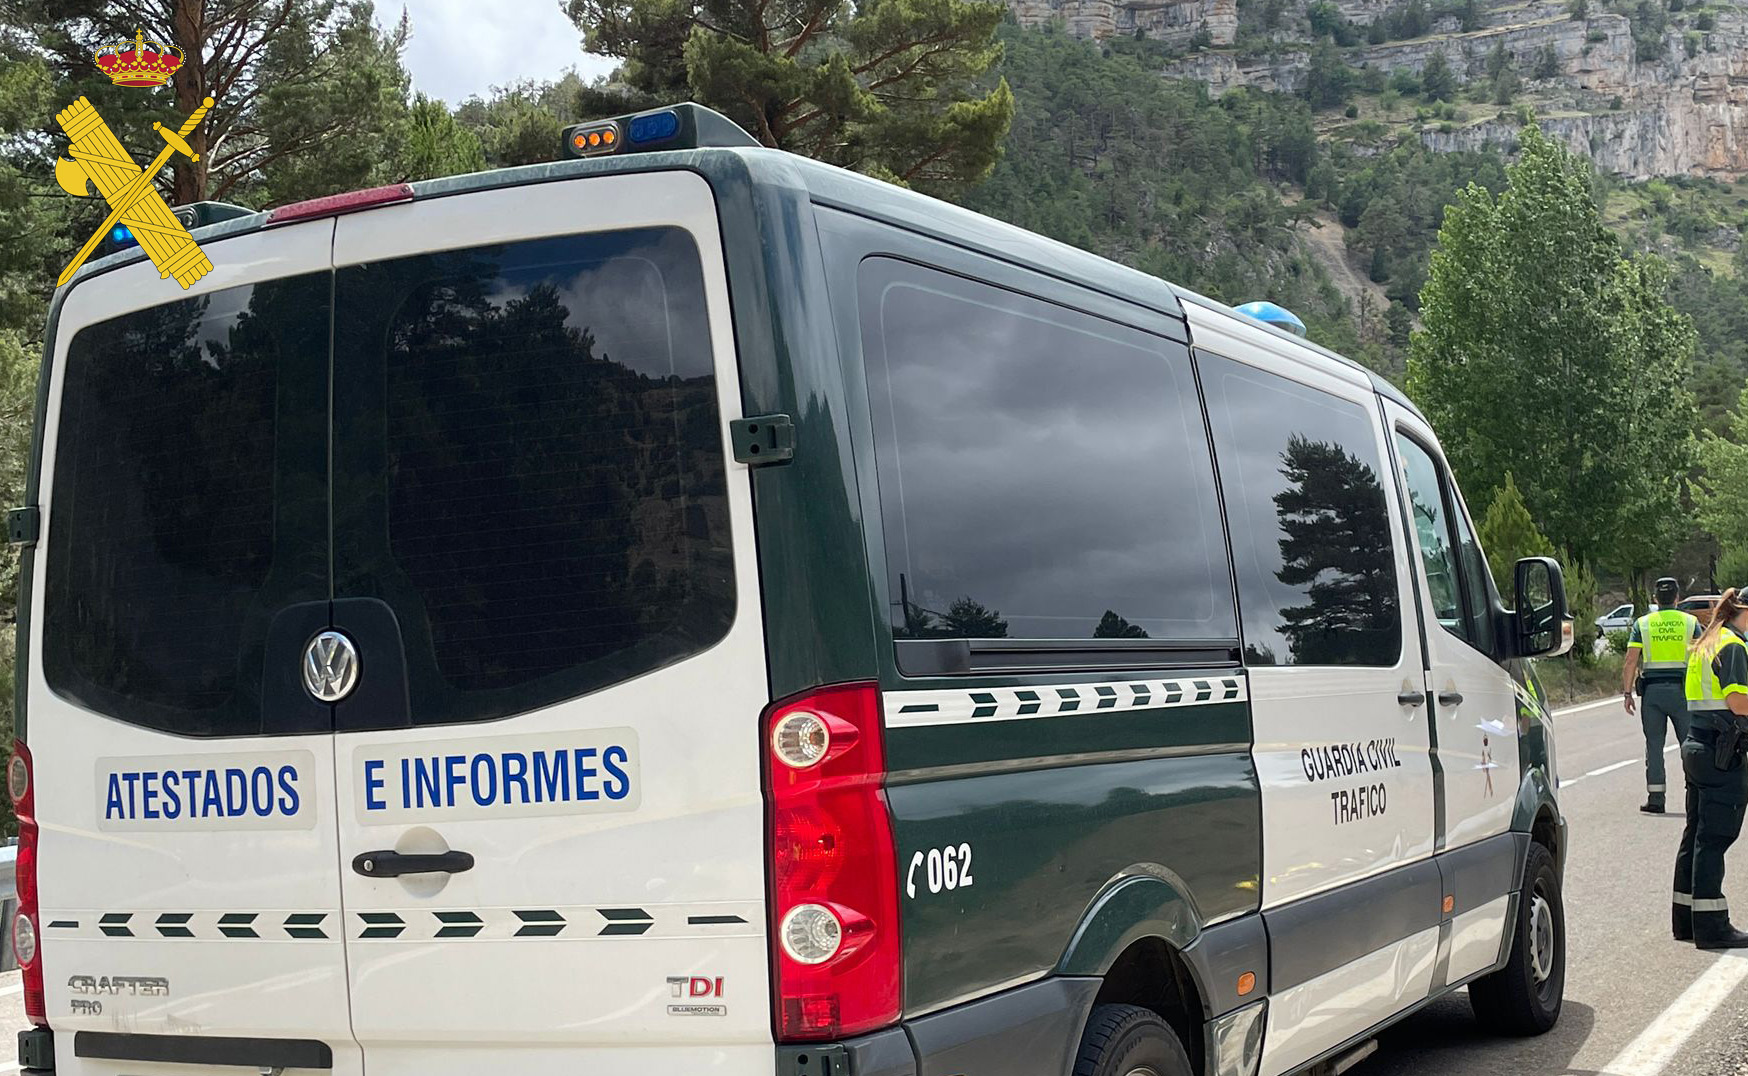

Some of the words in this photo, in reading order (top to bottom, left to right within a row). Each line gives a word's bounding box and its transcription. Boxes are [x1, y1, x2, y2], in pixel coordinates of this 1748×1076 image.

[1301, 742, 1369, 782] GUARDIA
[1367, 738, 1401, 771] CIVIL
[105, 765, 300, 820] ATESTADOS
[364, 759, 387, 811] E
[401, 745, 631, 809] INFORMES
[1331, 783, 1386, 825] TRAFICO
[927, 842, 973, 894] 062
[67, 975, 170, 996] CRAFTER
[666, 976, 724, 997] TDI
[70, 999, 103, 1016] PRO
